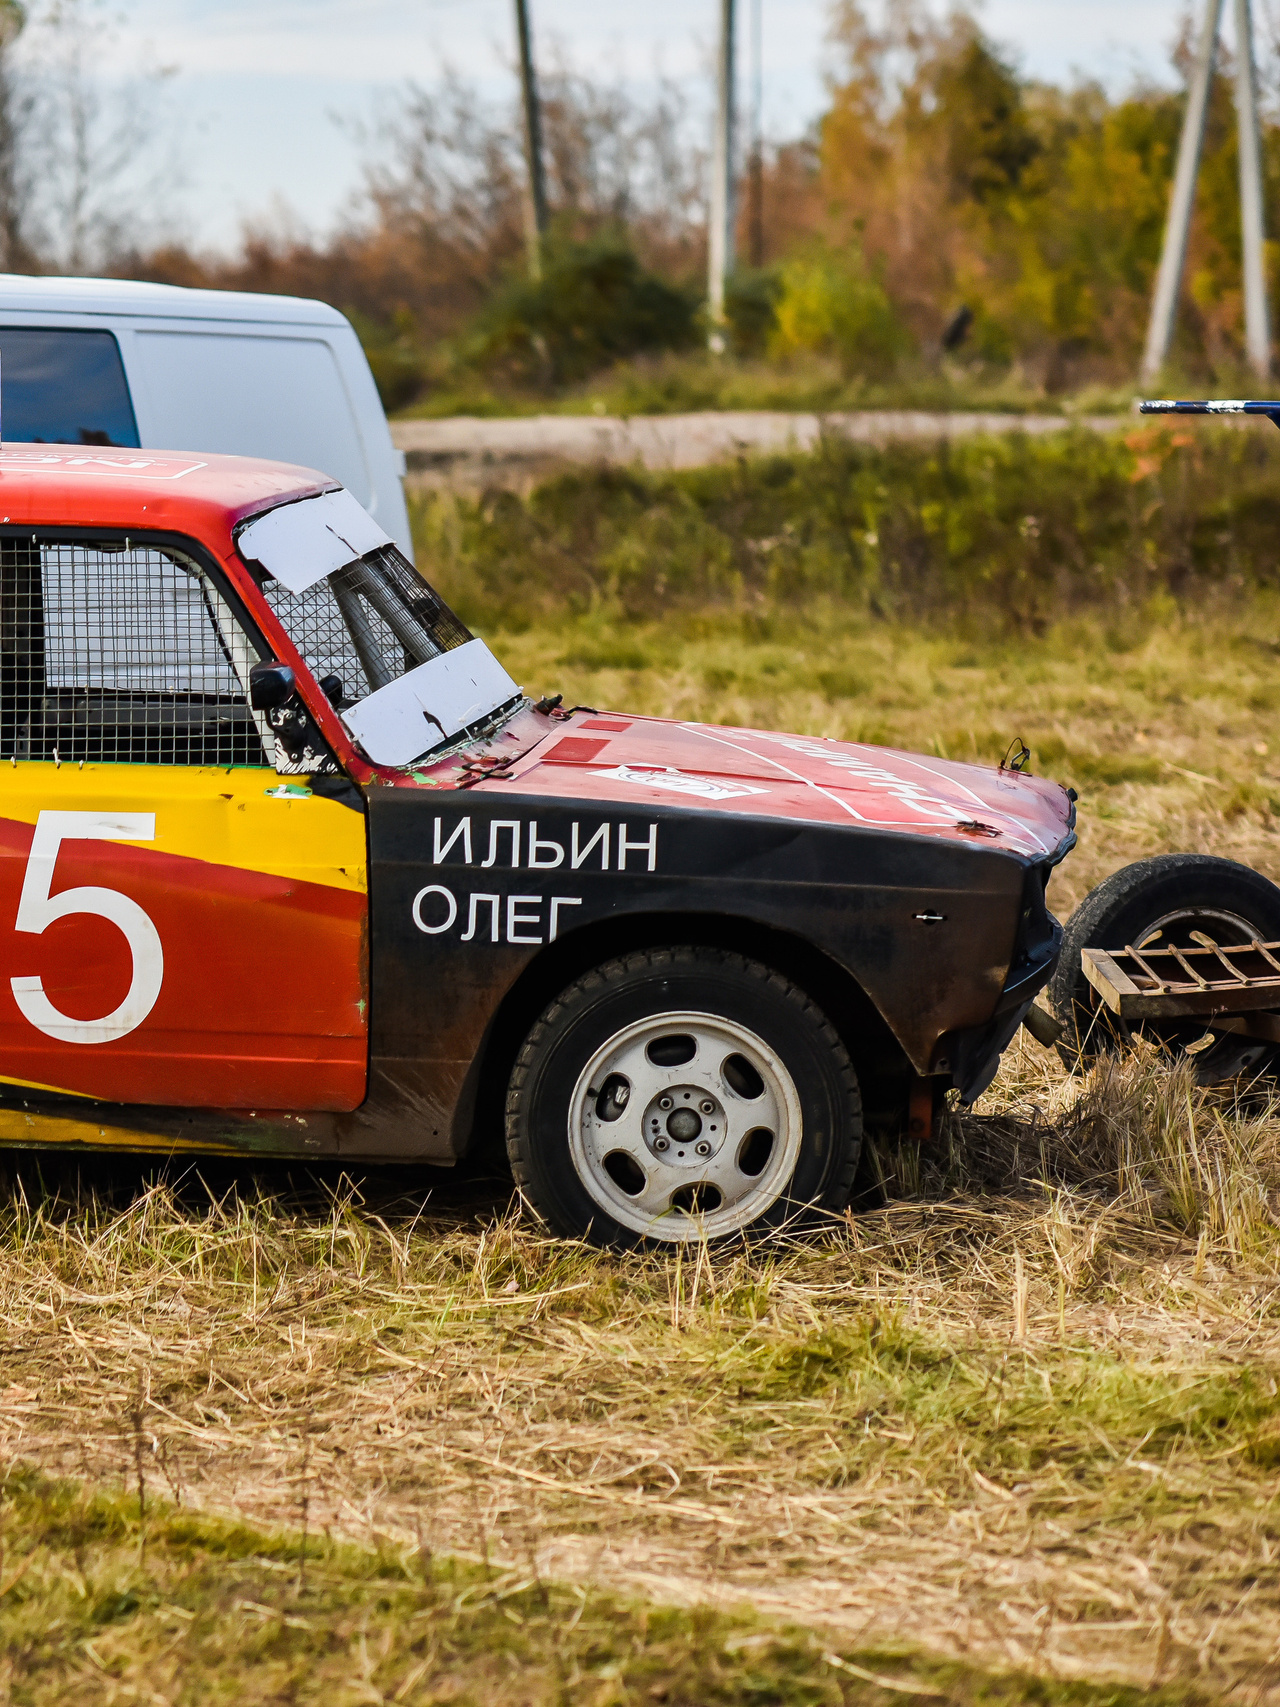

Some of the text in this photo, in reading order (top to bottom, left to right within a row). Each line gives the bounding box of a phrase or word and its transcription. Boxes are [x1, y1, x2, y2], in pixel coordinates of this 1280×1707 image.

[432, 816, 658, 872] ИЛЬИН
[10, 810, 164, 1044] 5
[412, 884, 583, 944] ОЛЕГ
